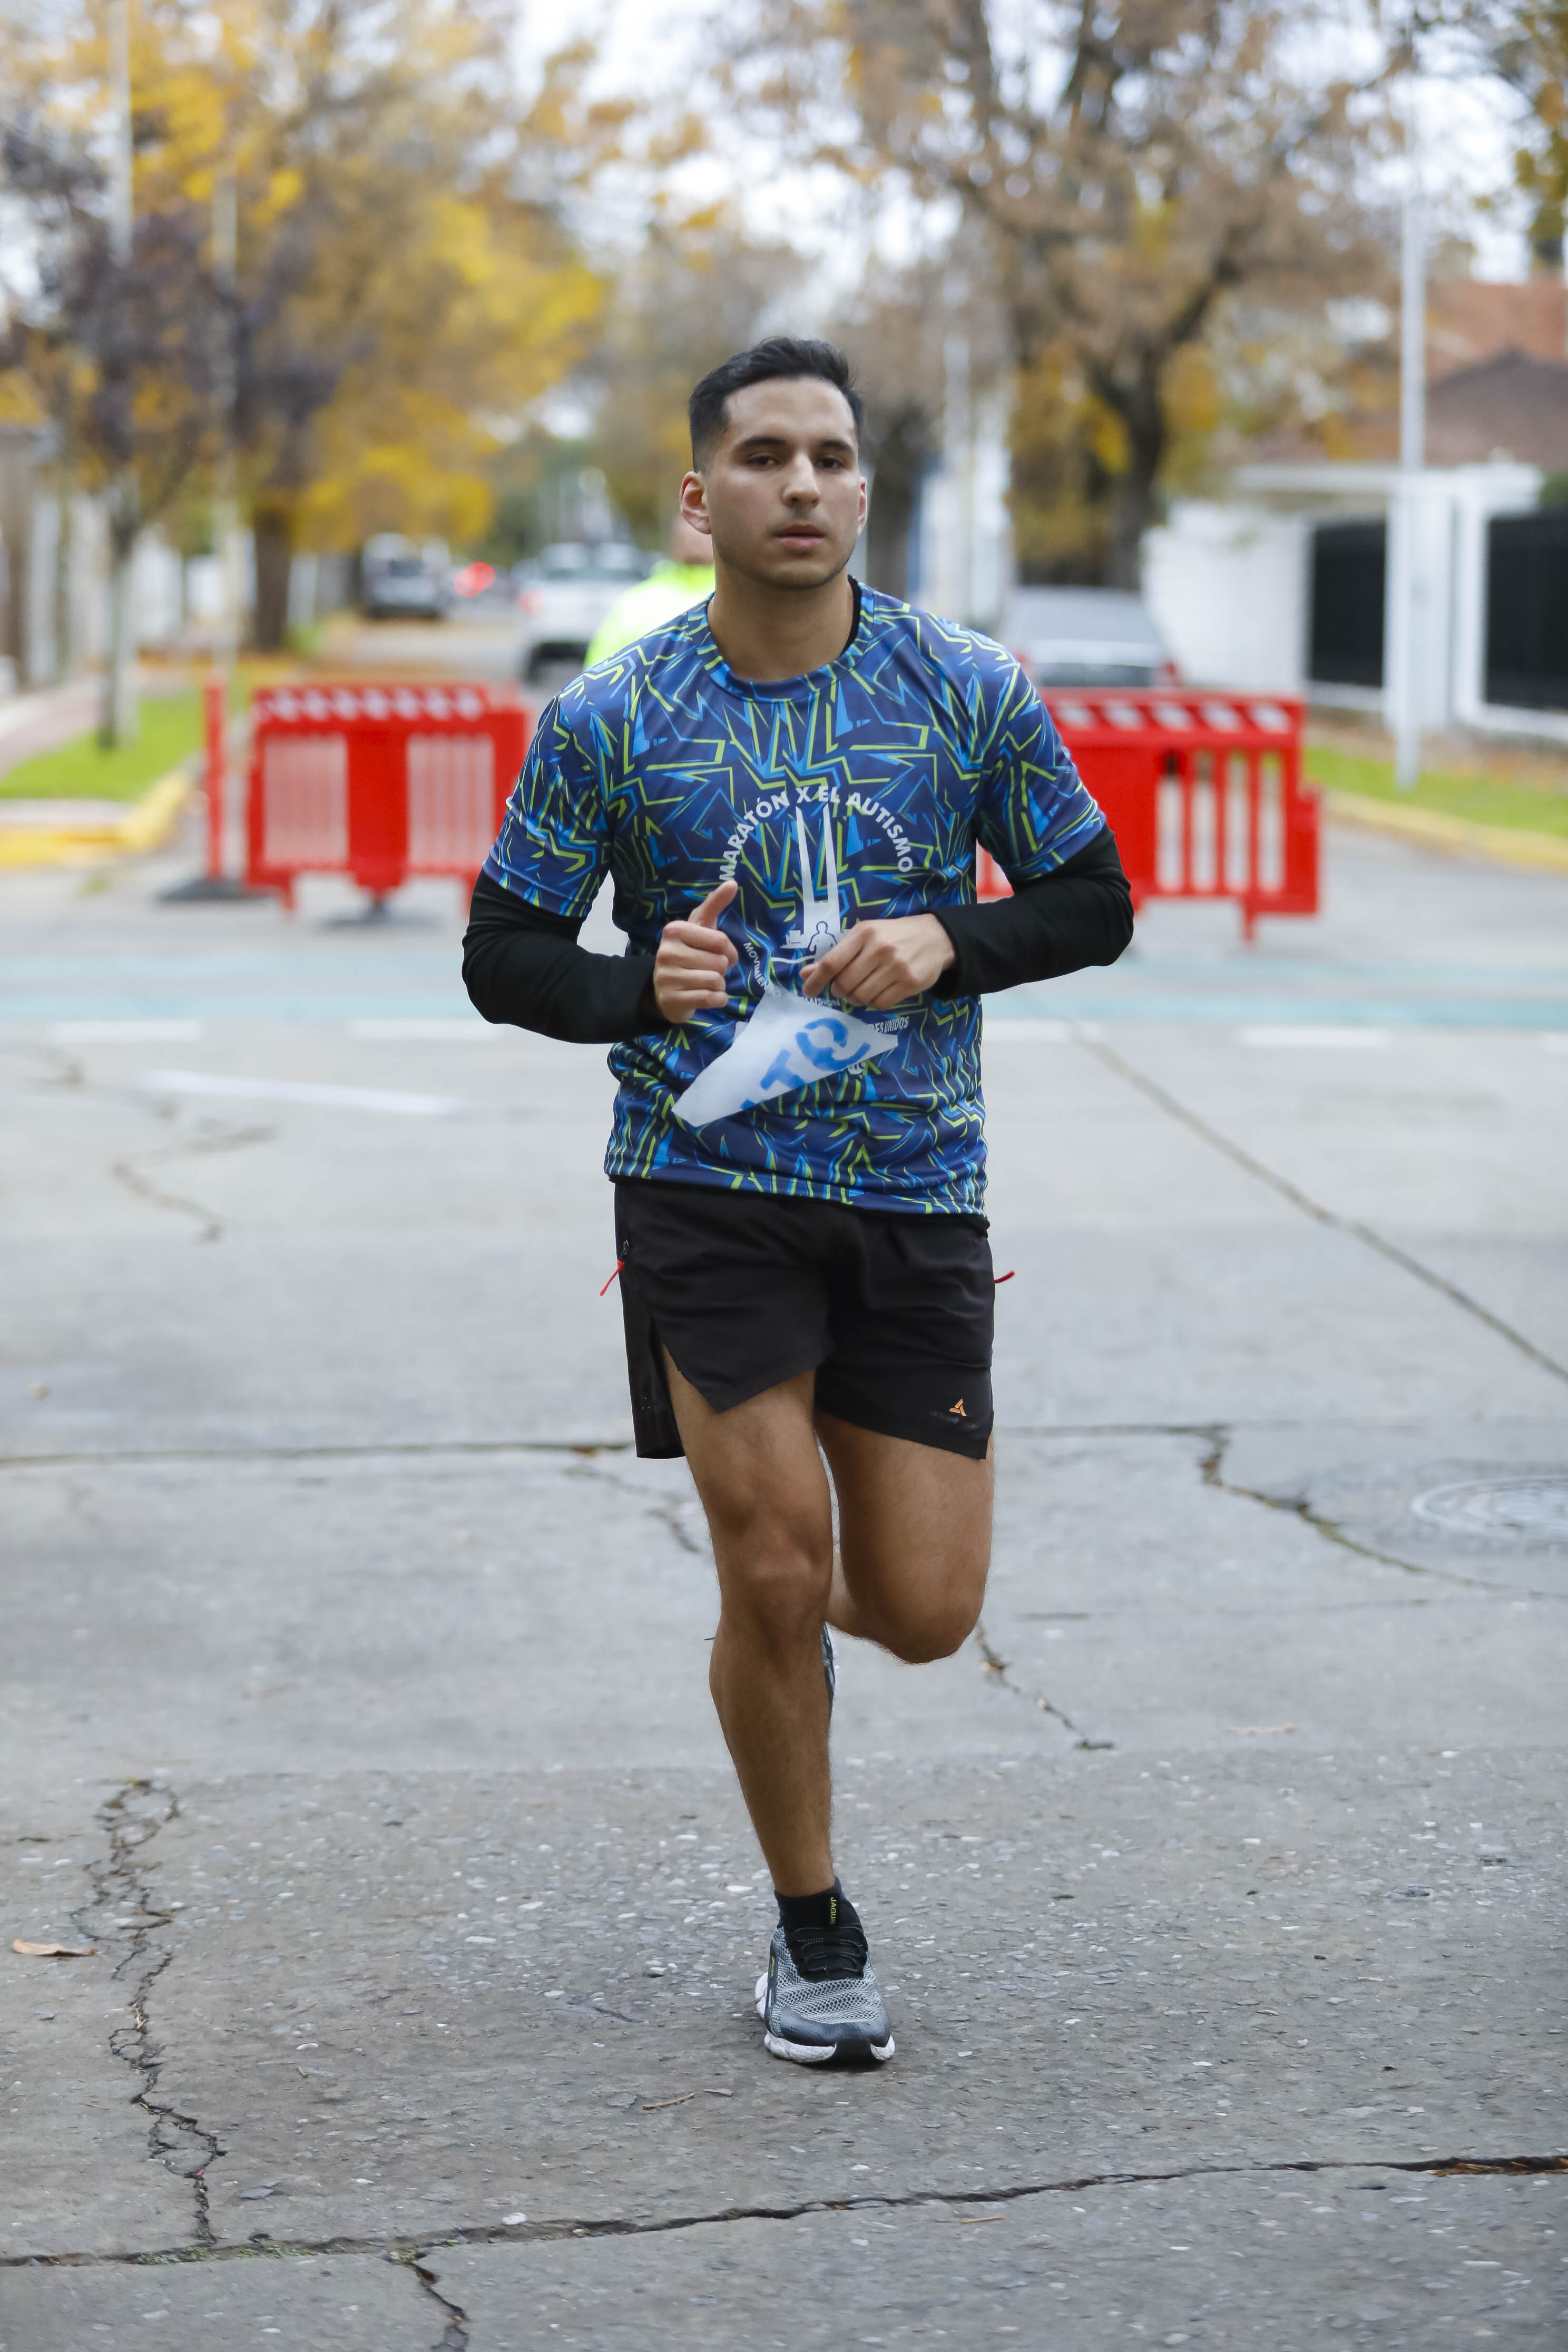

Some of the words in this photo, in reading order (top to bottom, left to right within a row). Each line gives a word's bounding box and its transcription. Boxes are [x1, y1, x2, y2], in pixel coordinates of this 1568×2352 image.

[719, 791, 790, 881] MARATÓN
[796, 787, 812, 803] X
[818, 786, 840, 803] EL
[845, 792, 913, 872] AUTISMO
[884, 1016, 909, 1033] UNIDOS
